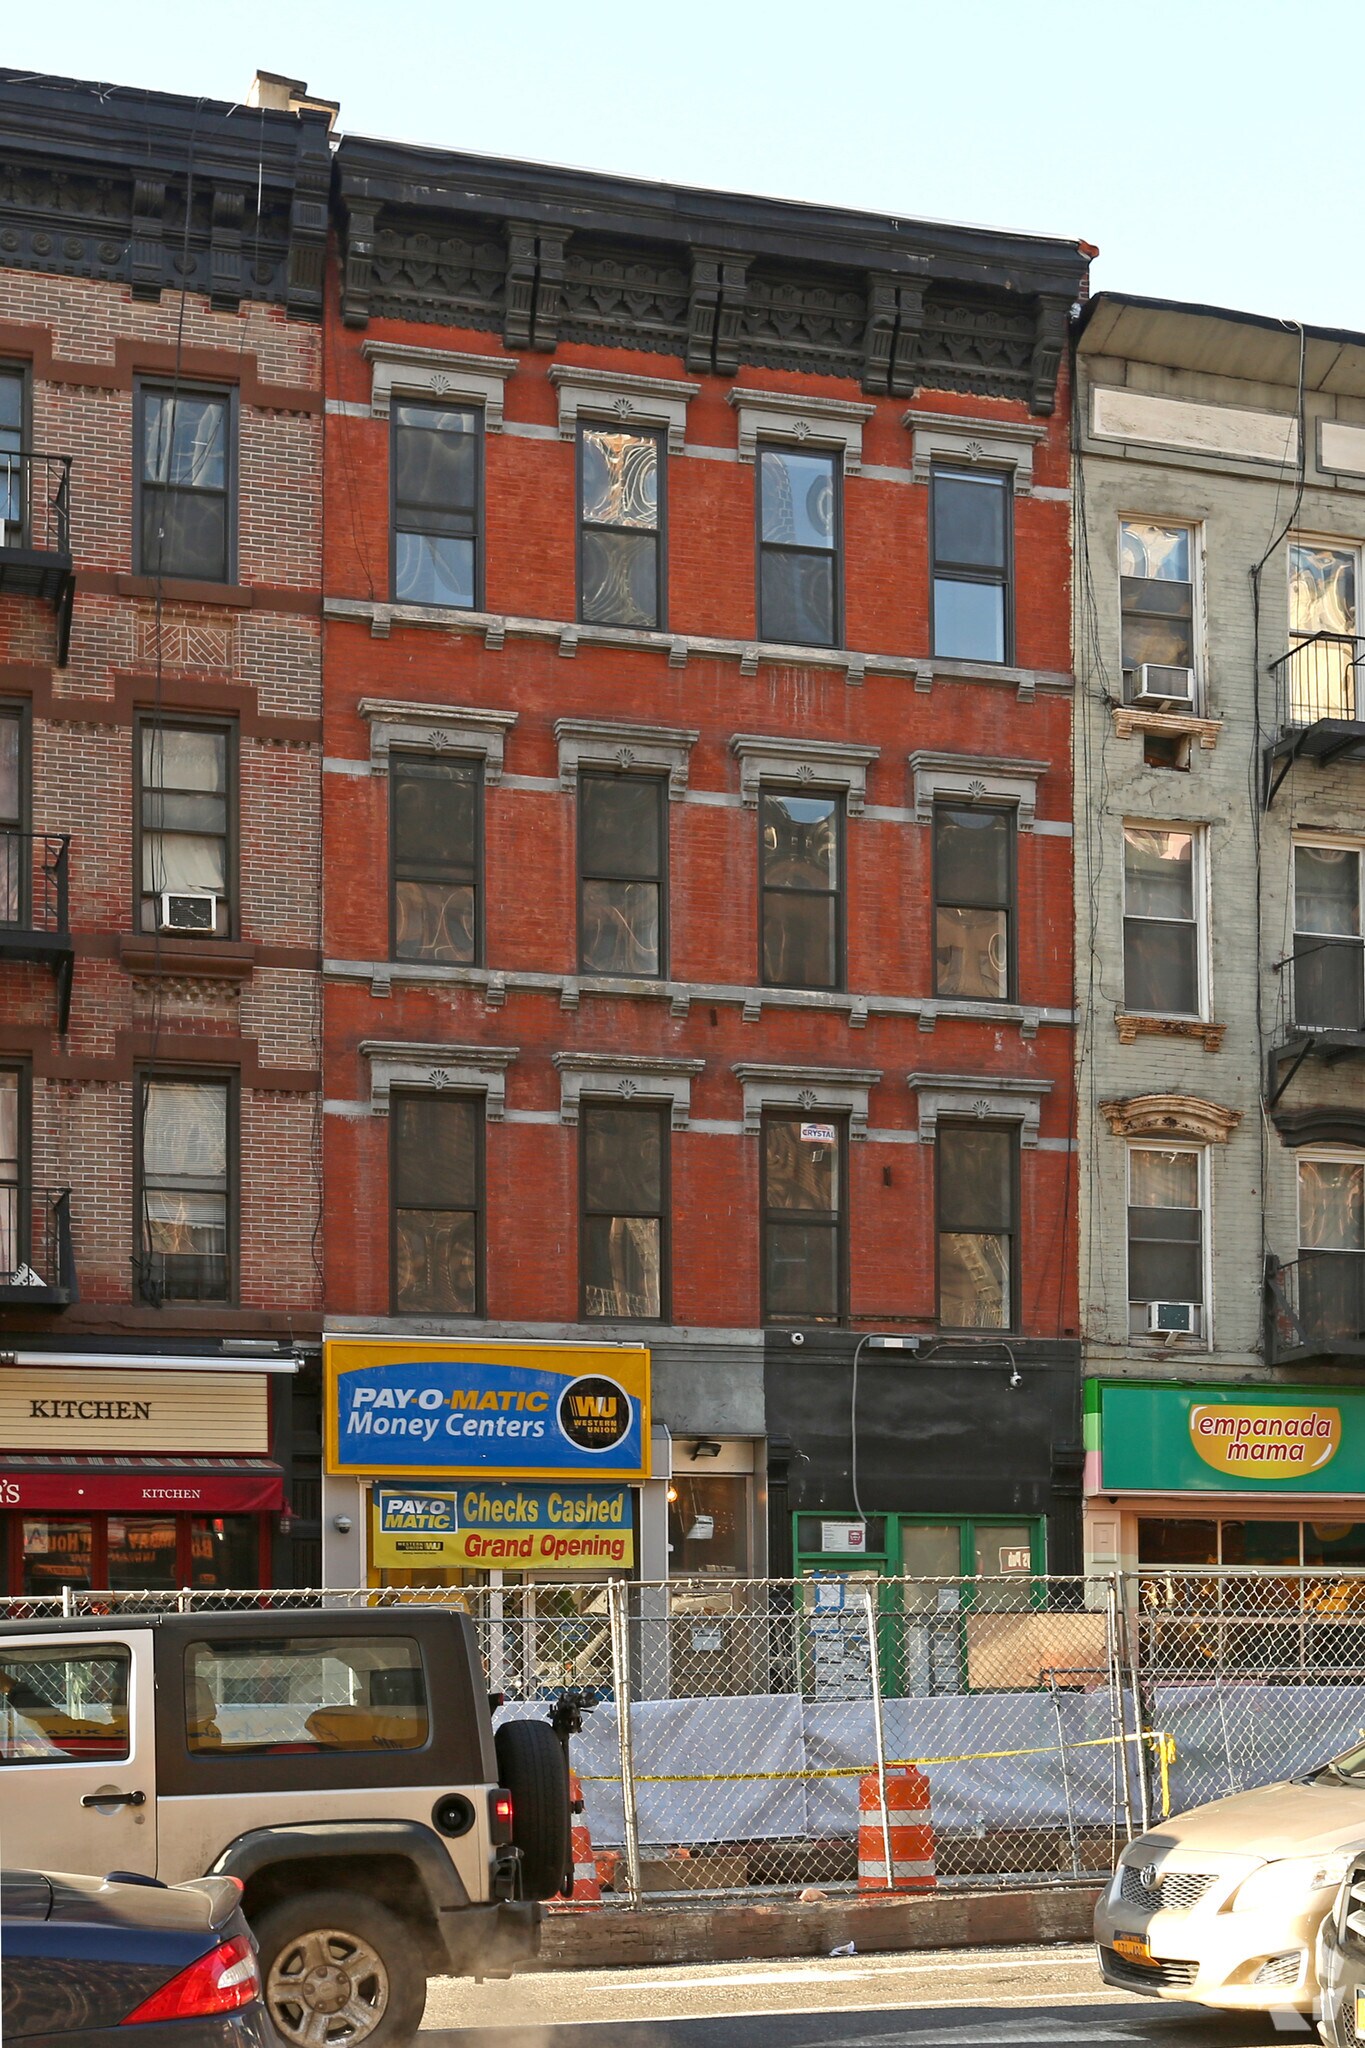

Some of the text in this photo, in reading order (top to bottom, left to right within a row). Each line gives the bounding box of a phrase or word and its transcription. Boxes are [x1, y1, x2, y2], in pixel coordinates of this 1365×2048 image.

[802, 1129, 835, 1138] CRYSTAL
[29, 1400, 152, 1420] KITCHEN
[352, 1387, 550, 1412] PAY-O-MATIC
[568, 1396, 617, 1418] WU
[346, 1411, 545, 1442] Money Centers
[574, 1419, 617, 1427] WESTERN
[1199, 1414, 1333, 1441] empanada
[1227, 1442, 1305, 1461] mama
[142, 1489, 201, 1499] KITCHEN
[463, 1491, 624, 1522] Checks Cashed
[385, 1514, 451, 1529] MATIC
[464, 1534, 625, 1560] Grand Opening
